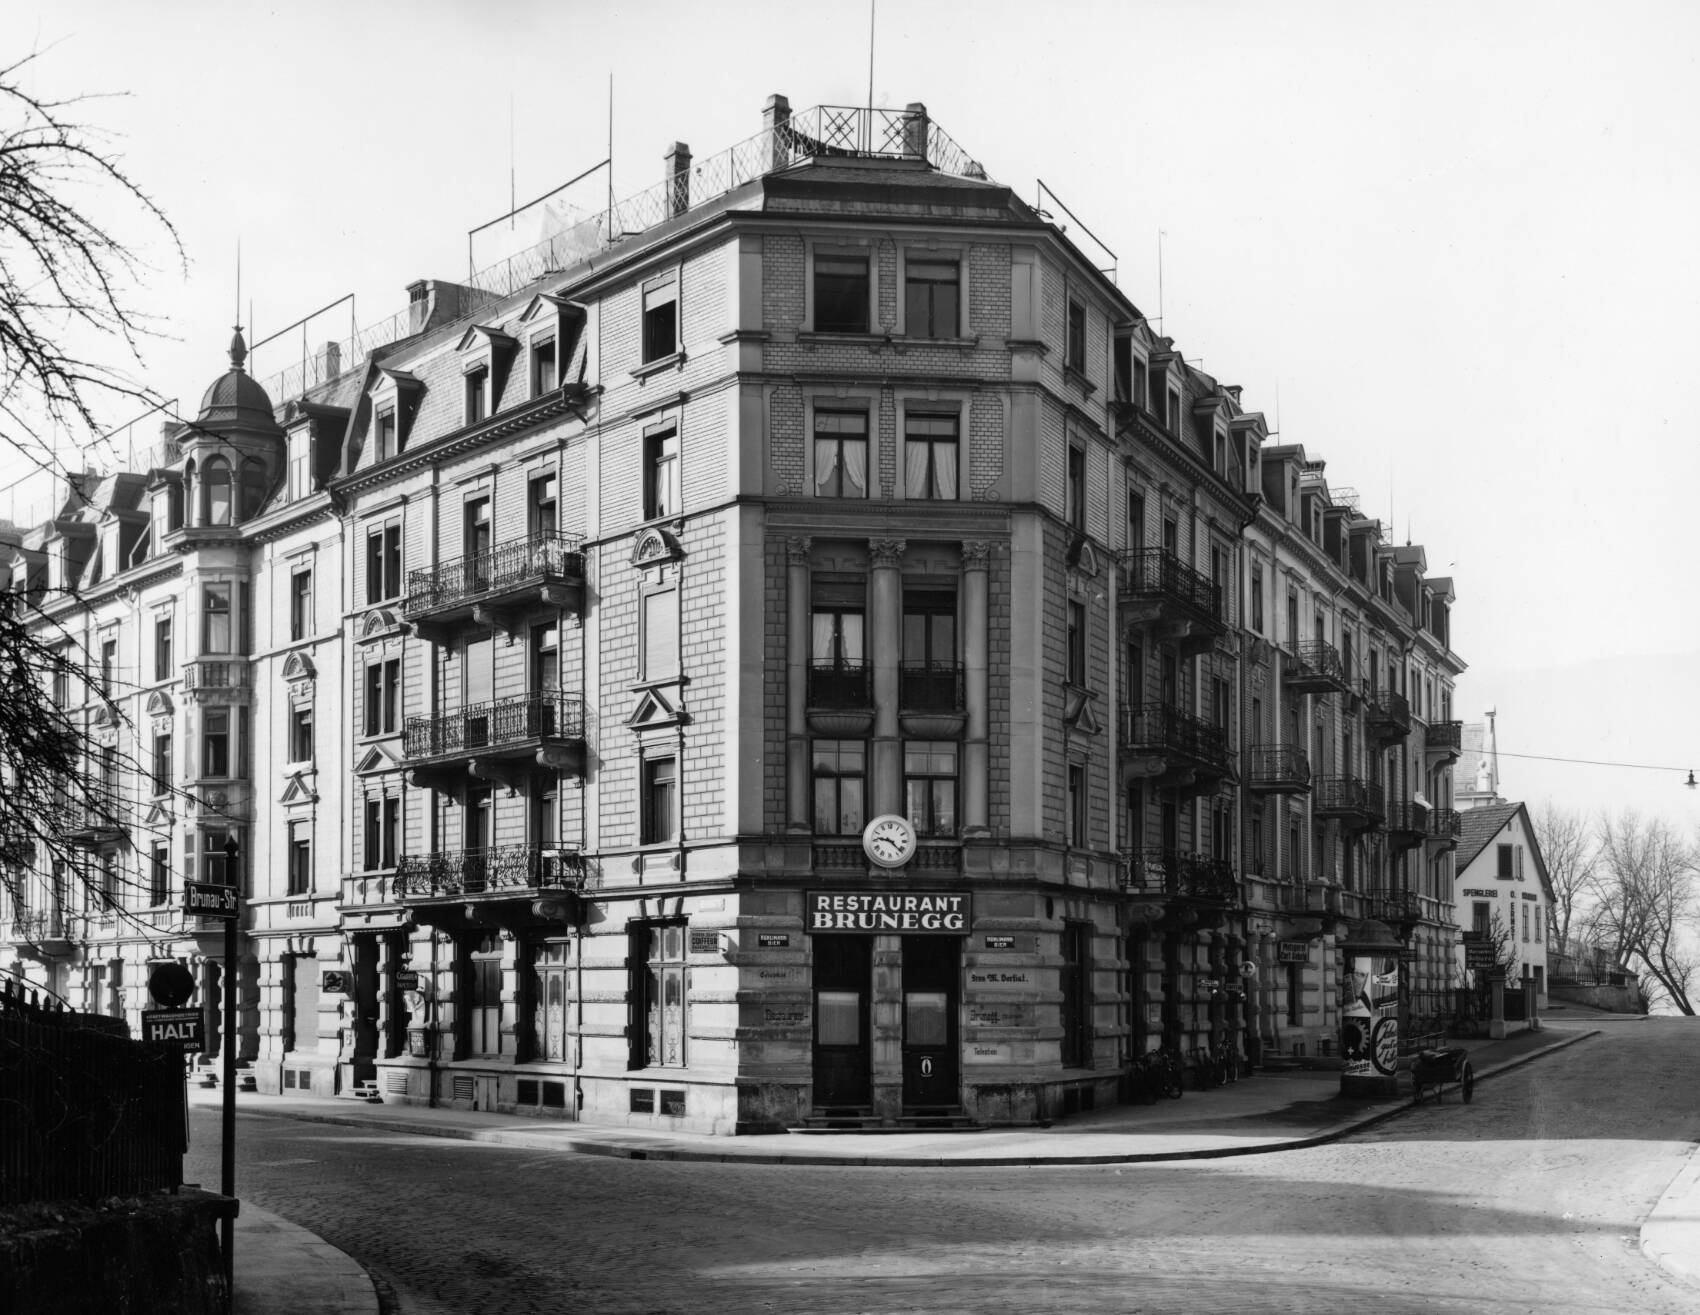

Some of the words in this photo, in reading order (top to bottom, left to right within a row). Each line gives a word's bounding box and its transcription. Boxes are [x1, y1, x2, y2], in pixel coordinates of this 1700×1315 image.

[1463, 888, 1498, 898] SPENGLEREI
[817, 895, 962, 912] RESTAURANT
[812, 911, 964, 930] BRUNEGG
[151, 1022, 197, 1041] HALT
